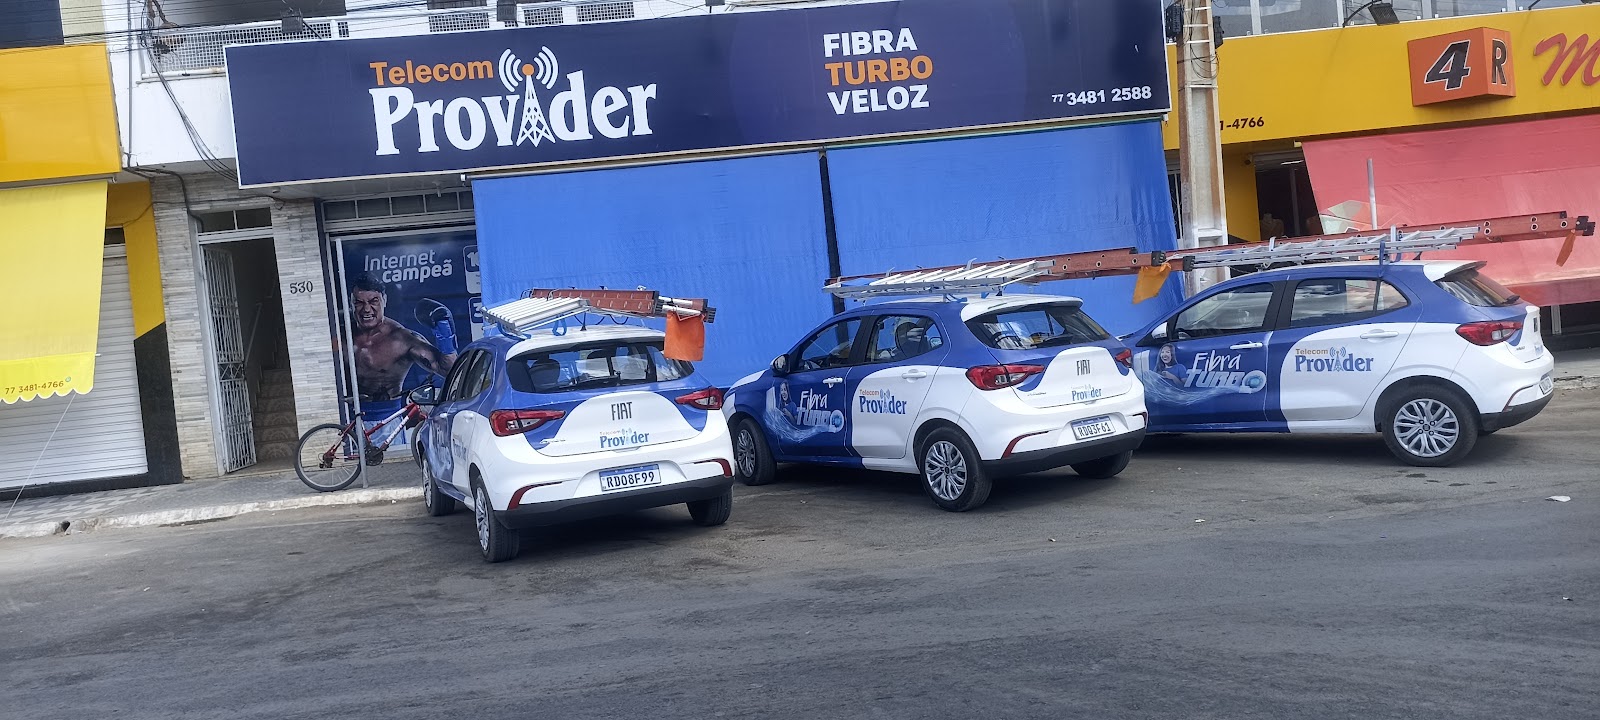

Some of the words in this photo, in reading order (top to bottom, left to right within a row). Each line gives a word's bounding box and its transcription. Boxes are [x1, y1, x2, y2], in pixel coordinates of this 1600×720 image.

[823, 27, 918, 58] FIBRA
[369, 59, 494, 86] Telecom
[824, 55, 934, 86] TURBO
[1423, 39, 1471, 91] 4
[1491, 38, 1508, 86] R
[827, 84, 930, 115] VELOZ
[1051, 93, 1065, 103] 77
[1066, 89, 1106, 106] 3481
[1111, 86, 1152, 102] 2588
[368, 68, 657, 155] Provider
[364, 249, 435, 272] Internet
[382, 258, 453, 283] campeã
[289, 280, 314, 295] 530
[1076, 359, 1091, 376] FIAT
[1191, 349, 1241, 373] Fibra
[1295, 352, 1374, 373] Provider
[5, 386, 16, 395] 77
[18, 380, 64, 393] 3481-4766
[799, 387, 828, 411] Fibra
[611, 401, 633, 421] FIAT
[859, 395, 907, 415] Provider
